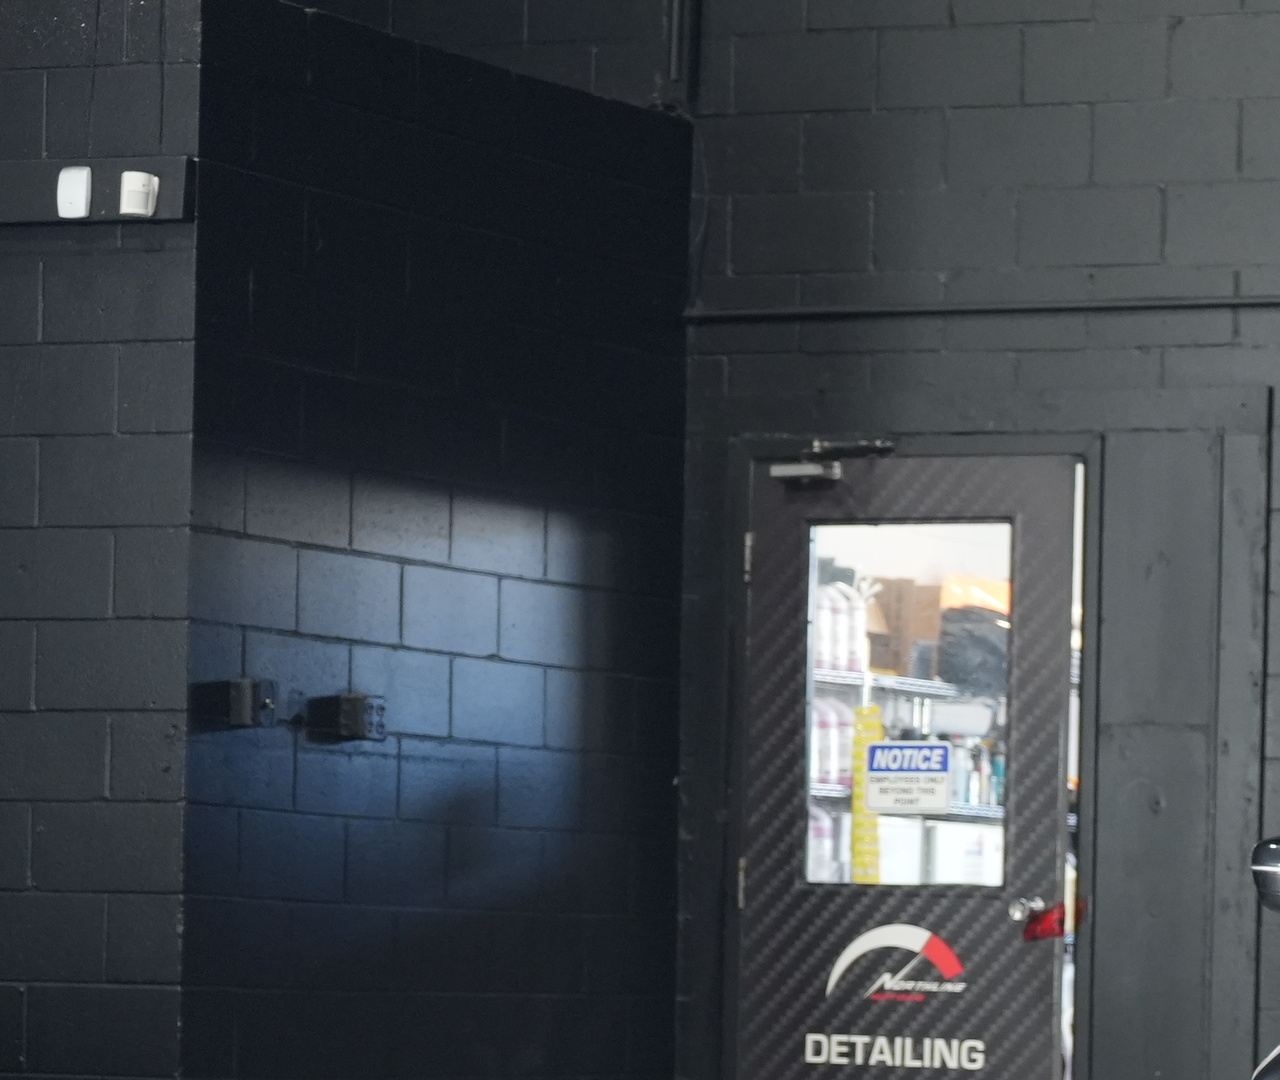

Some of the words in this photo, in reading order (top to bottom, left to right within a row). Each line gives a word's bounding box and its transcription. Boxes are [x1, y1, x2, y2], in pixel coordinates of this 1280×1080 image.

[872, 748, 944, 770] NOTICE
[870, 776, 920, 784] EMPLOYEES
[924, 776, 945, 784] ONLY
[879, 787, 914, 795] BEYOND
[917, 787, 935, 795] THIS
[804, 1032, 986, 1070] DETAILING
